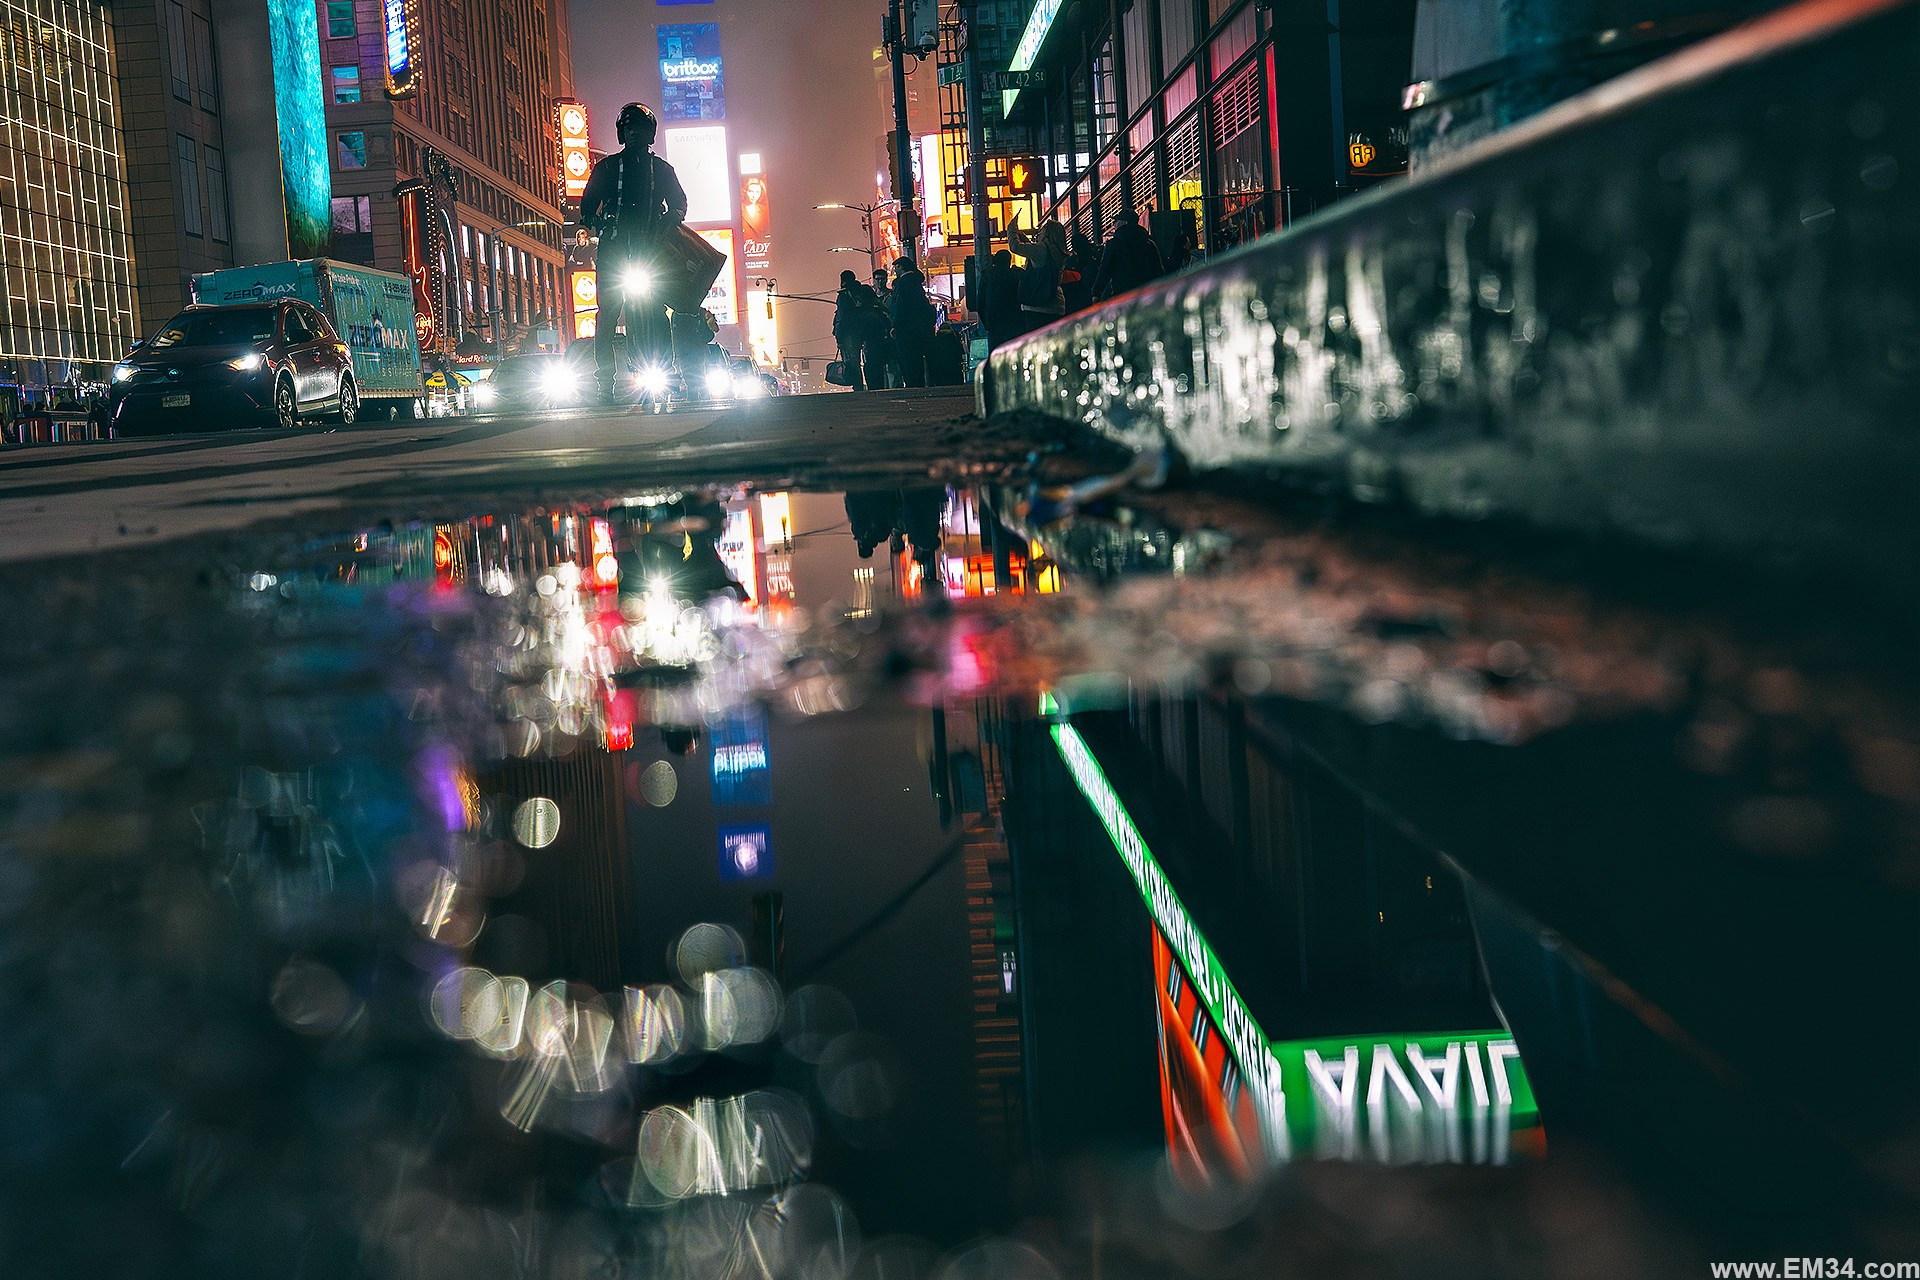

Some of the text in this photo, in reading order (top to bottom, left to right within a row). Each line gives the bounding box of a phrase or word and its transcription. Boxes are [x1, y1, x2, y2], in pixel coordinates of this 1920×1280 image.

[663, 61, 719, 77] britbox
[999, 74, 1010, 88] W
[1015, 72, 1030, 87] 42
[743, 242, 771, 255] LADY
